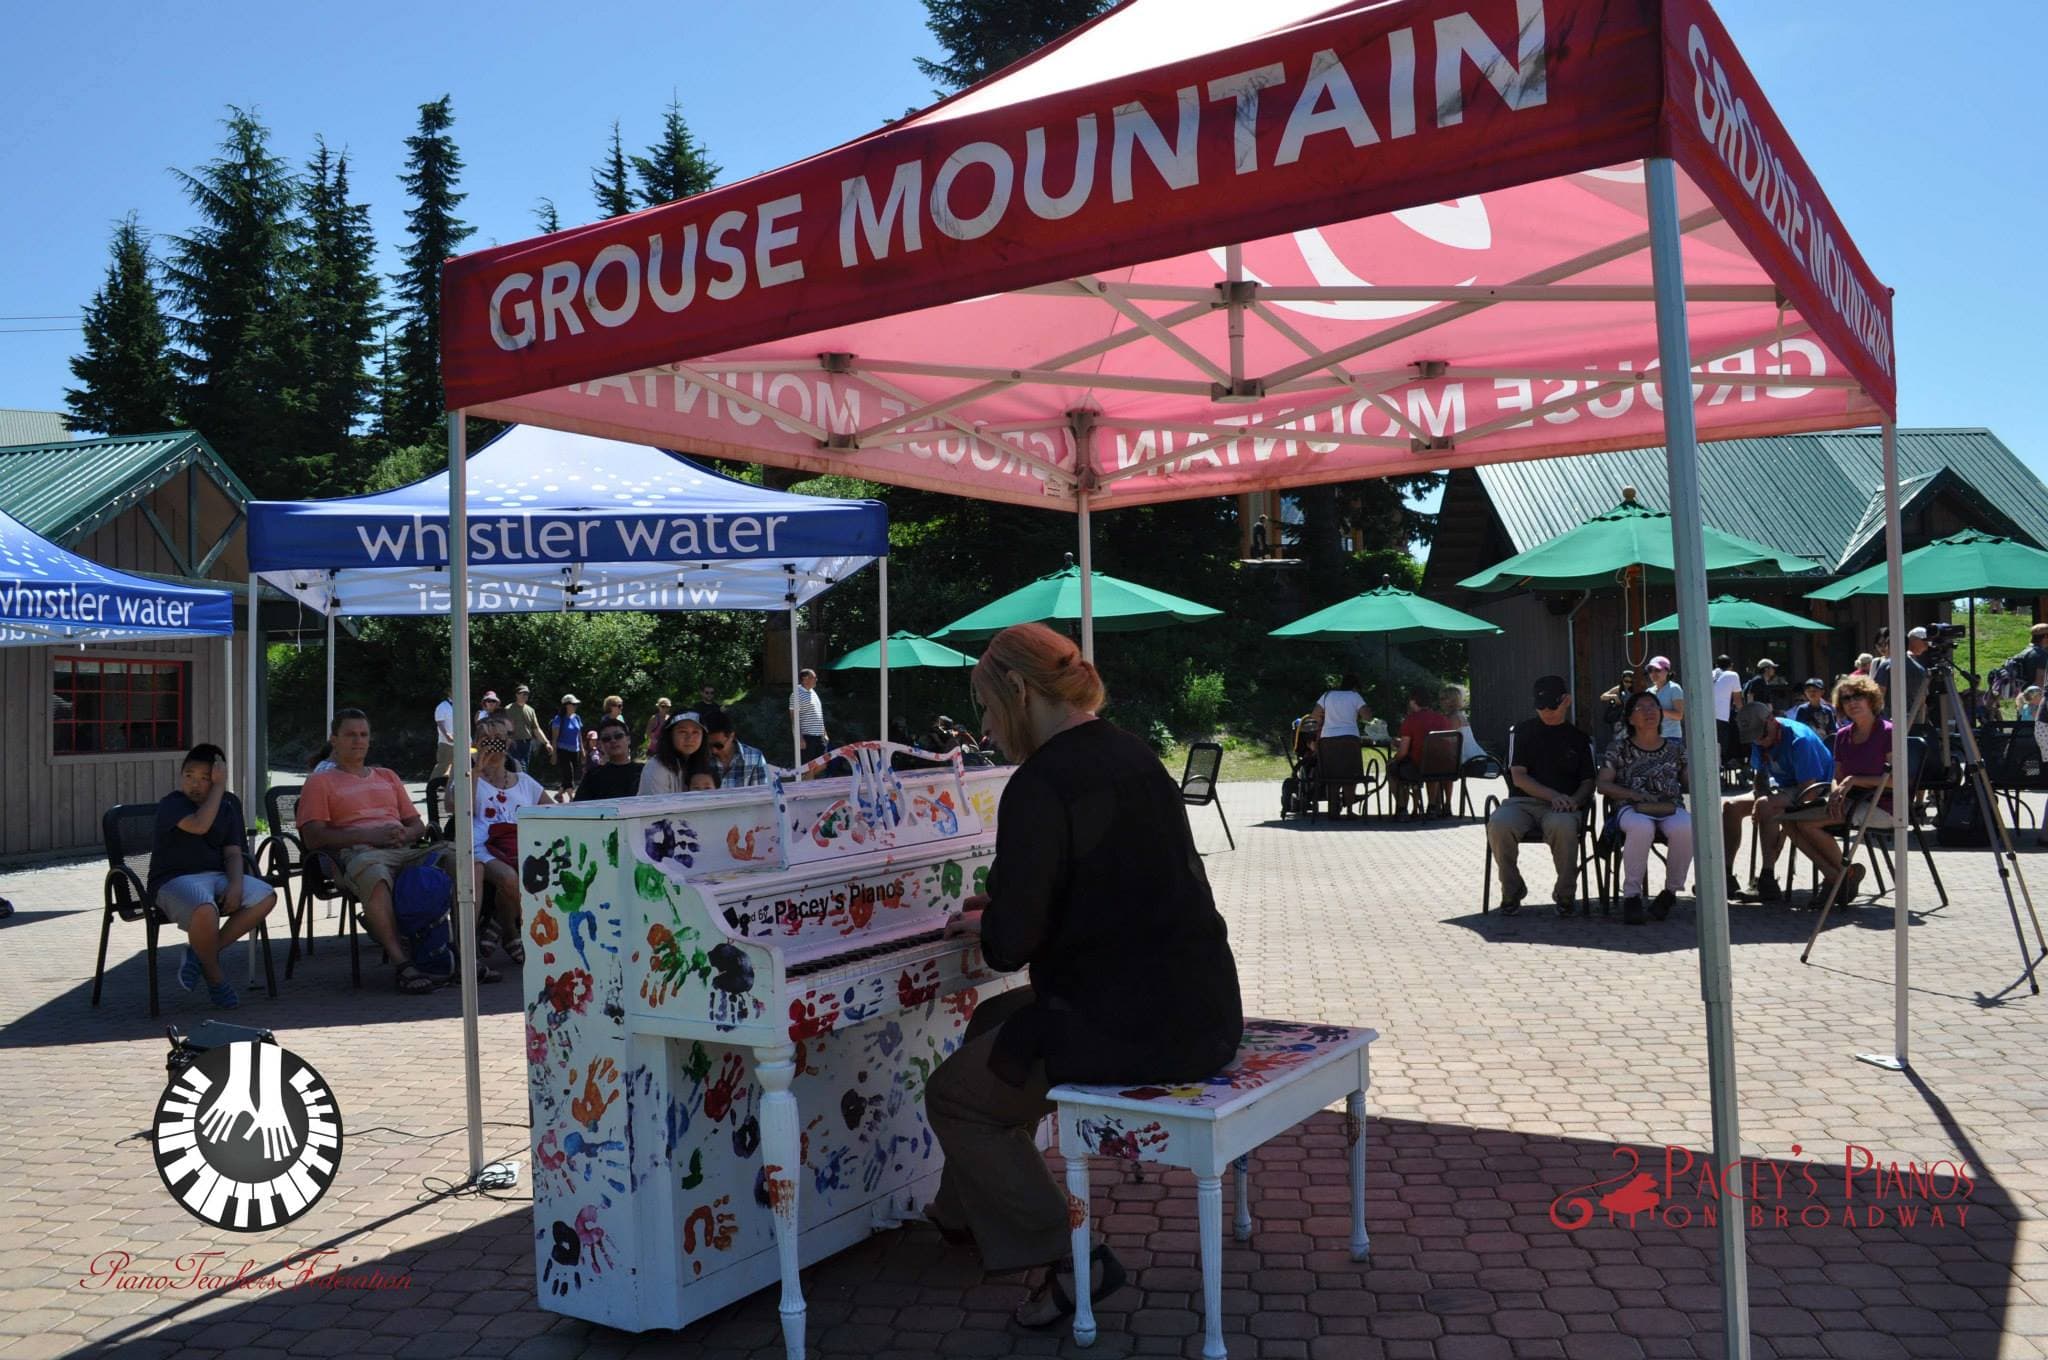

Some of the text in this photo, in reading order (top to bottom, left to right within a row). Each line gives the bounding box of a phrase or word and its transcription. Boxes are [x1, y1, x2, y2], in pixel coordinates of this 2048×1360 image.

[489, 0, 1548, 352] GROUSE MOUNTAIN
[1687, 23, 1892, 378] GROUSE MOUNTAIN
[356, 512, 788, 561] whstler water
[116, 595, 194, 627] water
[774, 888, 845, 925] Pacey's
[850, 877, 905, 906] Pianos
